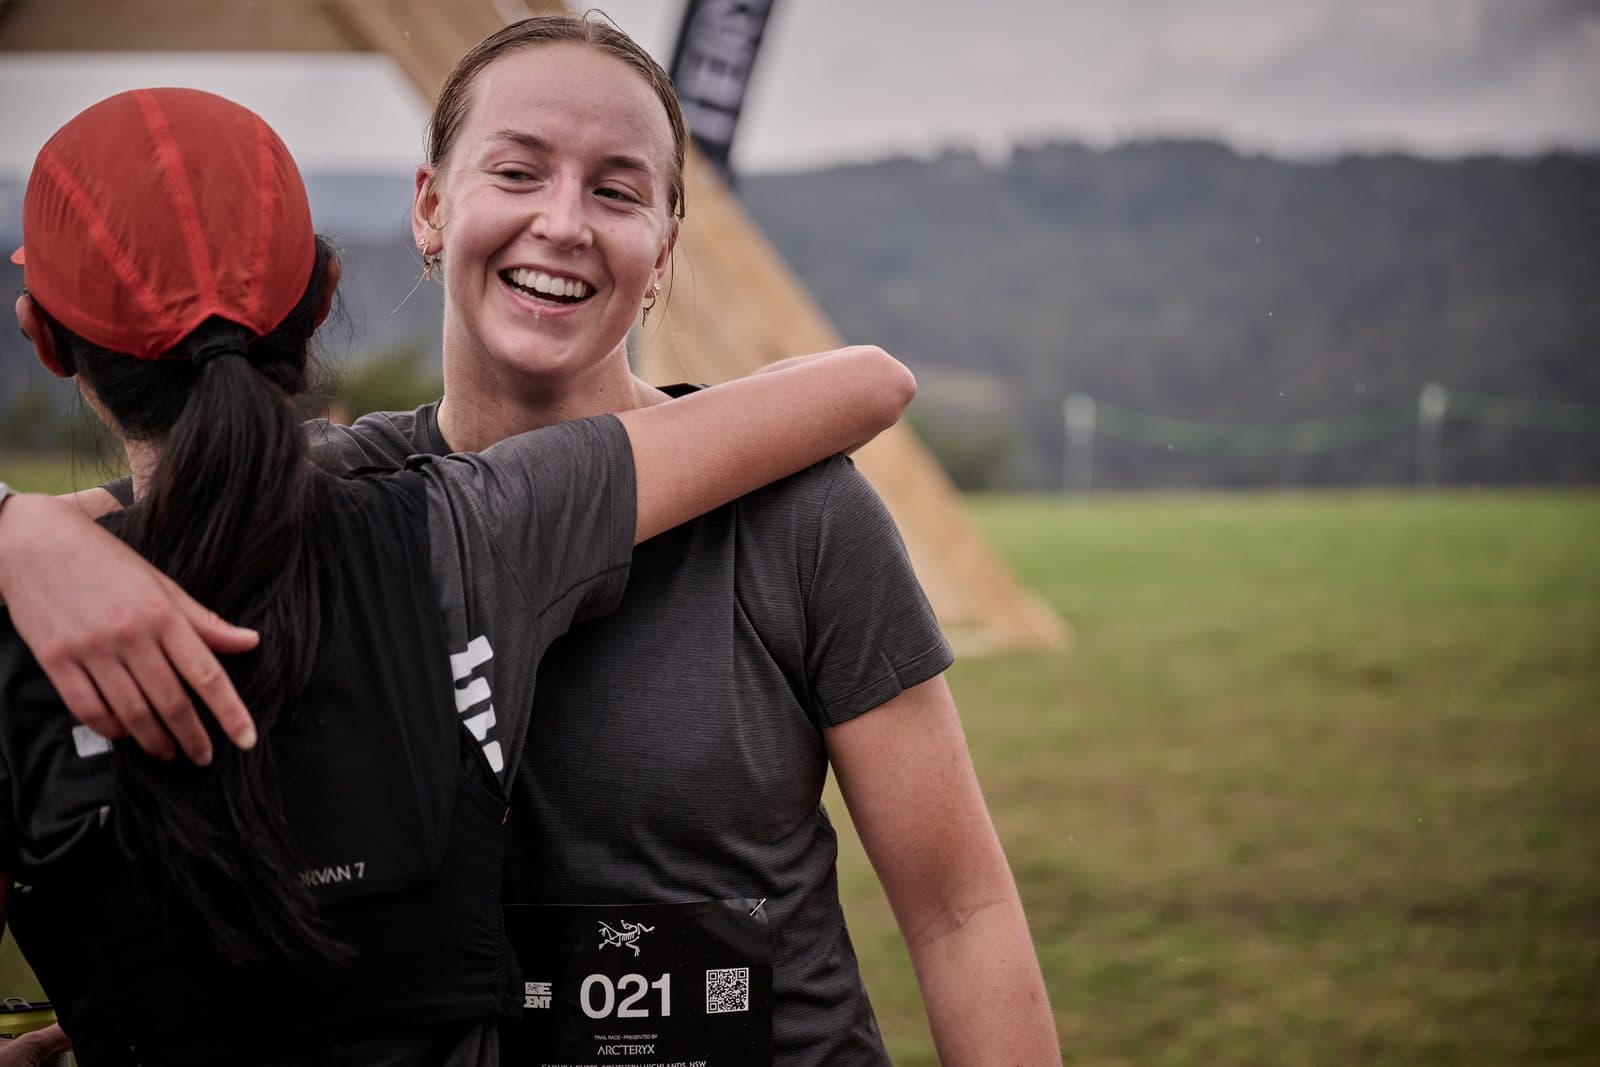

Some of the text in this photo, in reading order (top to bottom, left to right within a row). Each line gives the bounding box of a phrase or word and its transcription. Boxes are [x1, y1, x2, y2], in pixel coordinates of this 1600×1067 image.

[353, 861, 366, 880] 7
[580, 973, 671, 1019] 021
[597, 1044, 655, 1056] ARC'TERYX
